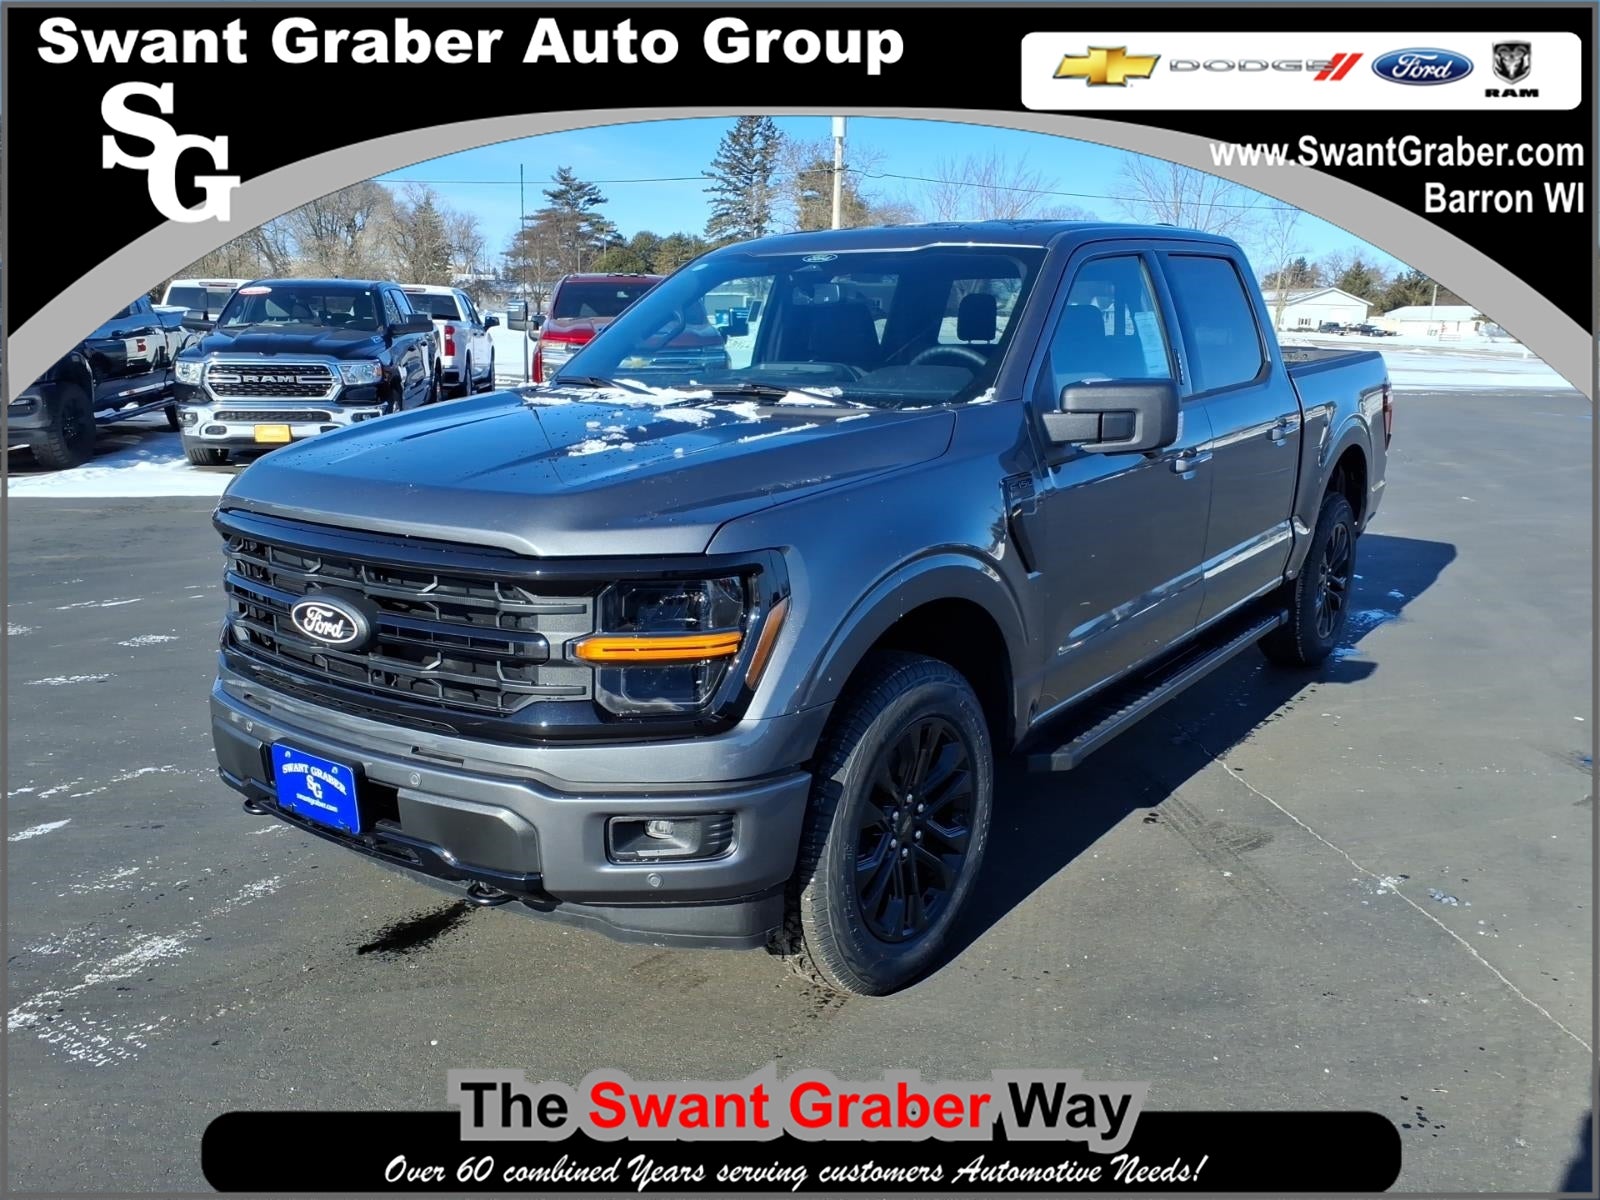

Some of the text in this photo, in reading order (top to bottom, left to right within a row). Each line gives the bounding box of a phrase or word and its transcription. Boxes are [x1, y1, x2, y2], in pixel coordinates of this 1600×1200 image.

[242, 374, 296, 384] RAM
[303, 606, 344, 638] Ford
[282, 763, 347, 796] SWANT GRABER
